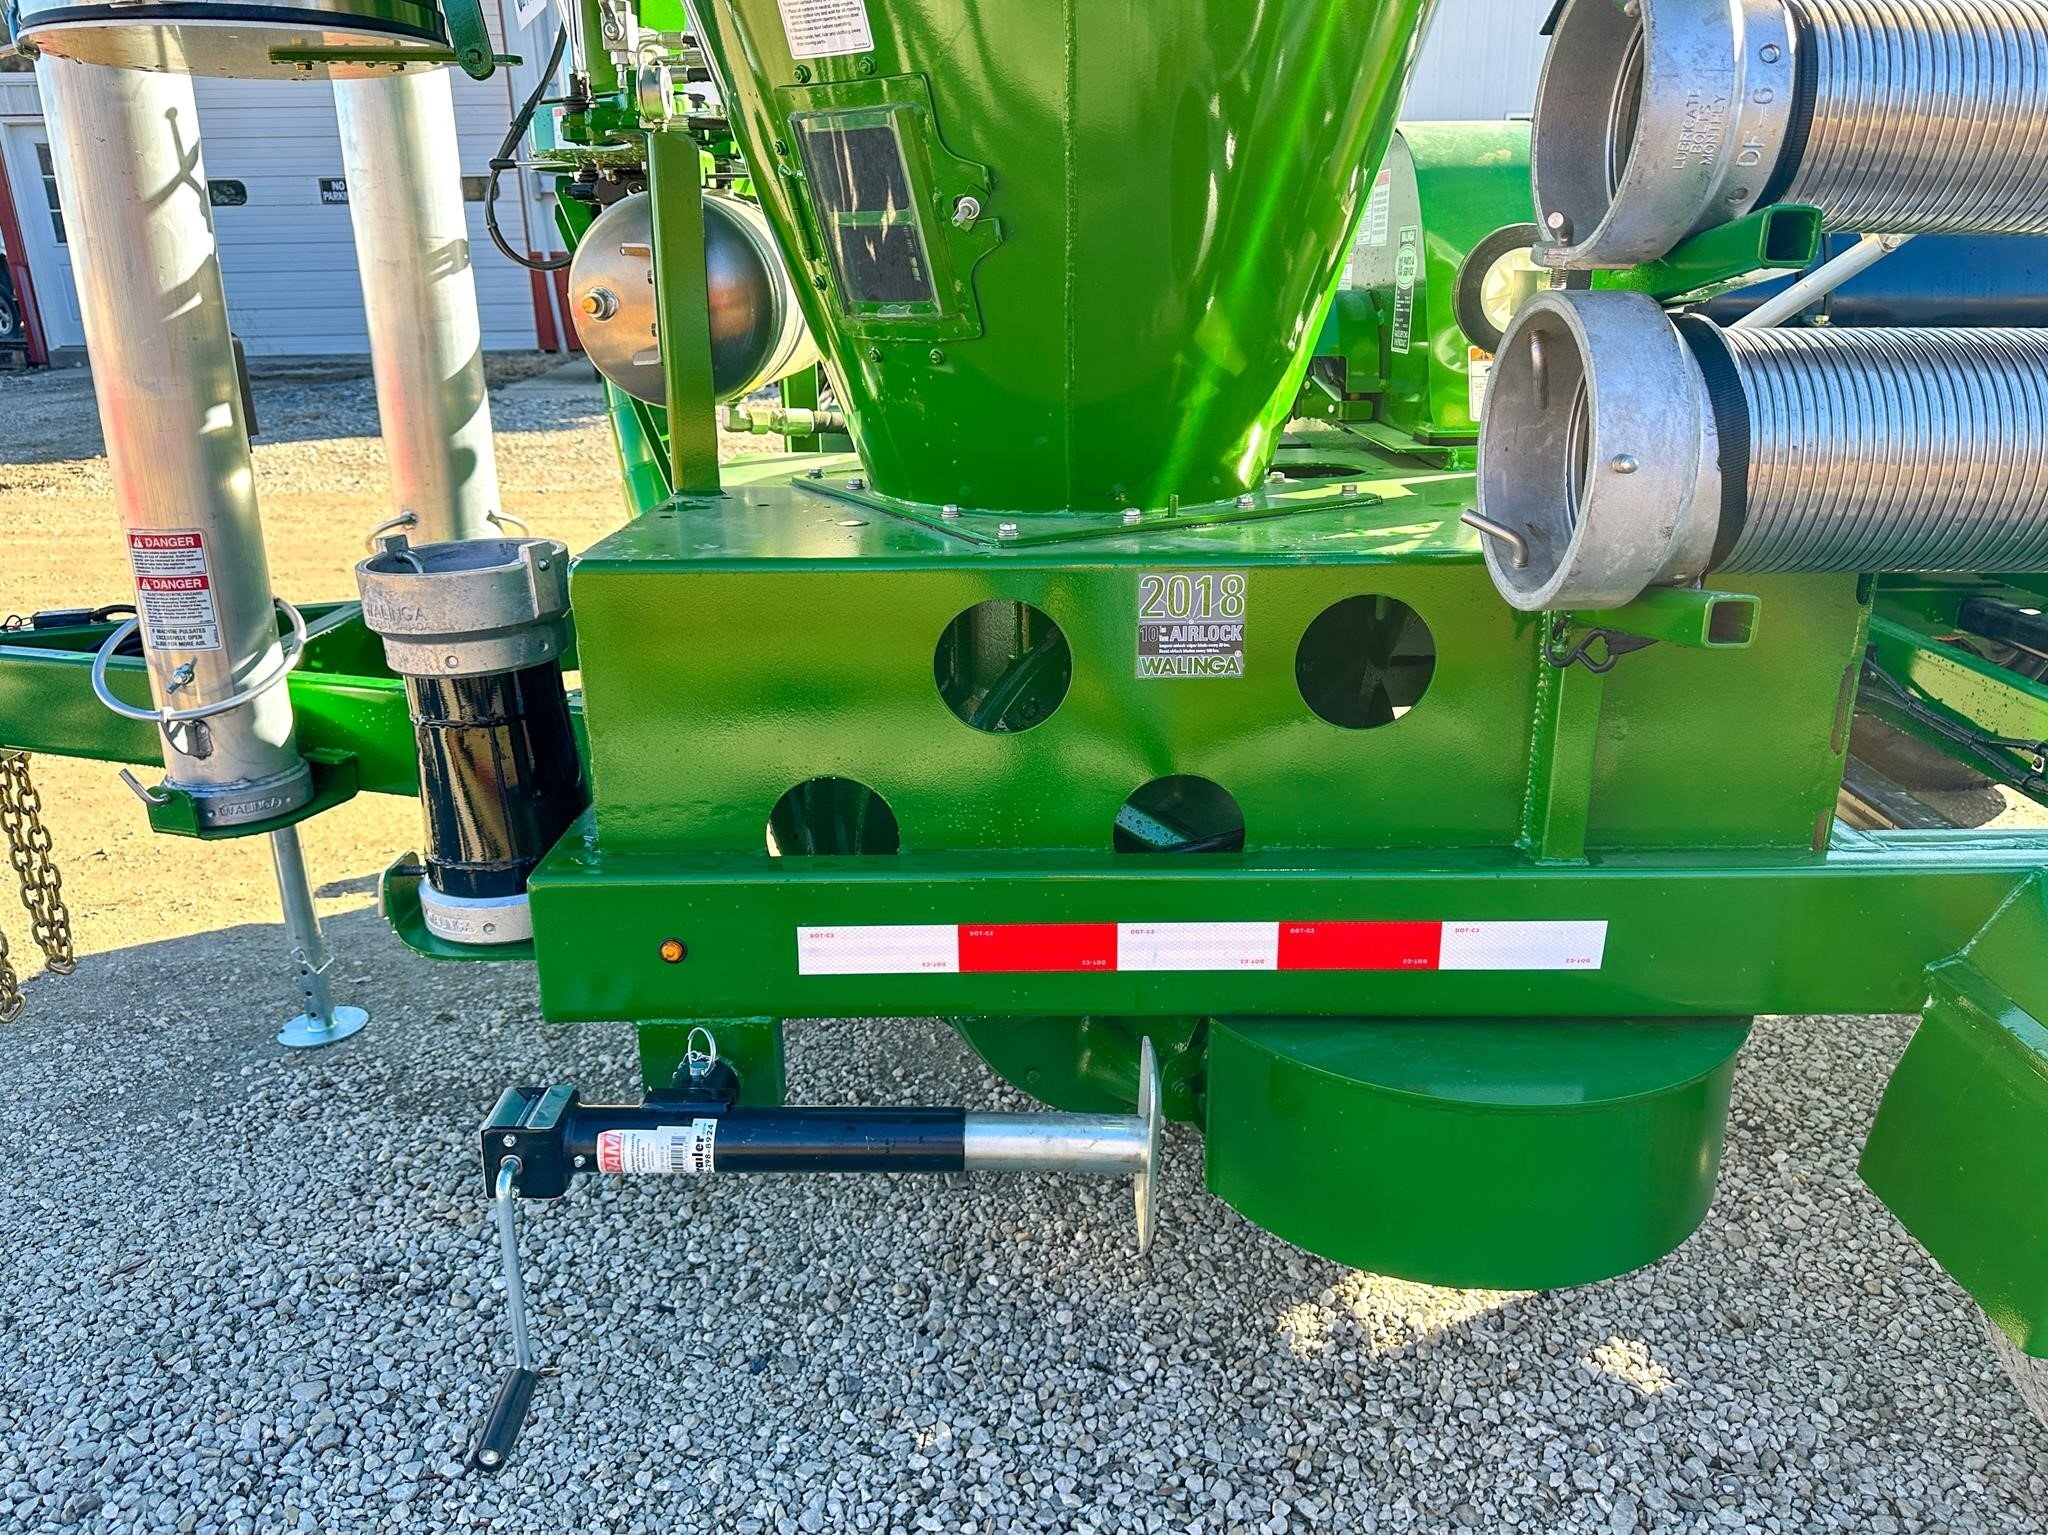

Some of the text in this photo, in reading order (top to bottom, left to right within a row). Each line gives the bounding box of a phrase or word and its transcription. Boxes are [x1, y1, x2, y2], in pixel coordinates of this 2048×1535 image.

[1671, 89, 1700, 170] LUBRICATE
[1690, 104, 1710, 154] BOLTS
[1700, 94, 1726, 166] MONTHLY
[331, 181, 346, 190] NO
[144, 536, 195, 548] DANGER
[152, 578, 202, 590] DANGER
[1140, 574, 1245, 618] 2018
[1140, 626, 1159, 642] 10
[1169, 624, 1244, 642] AIRLOCK
[1140, 656, 1242, 676] WALINGA
